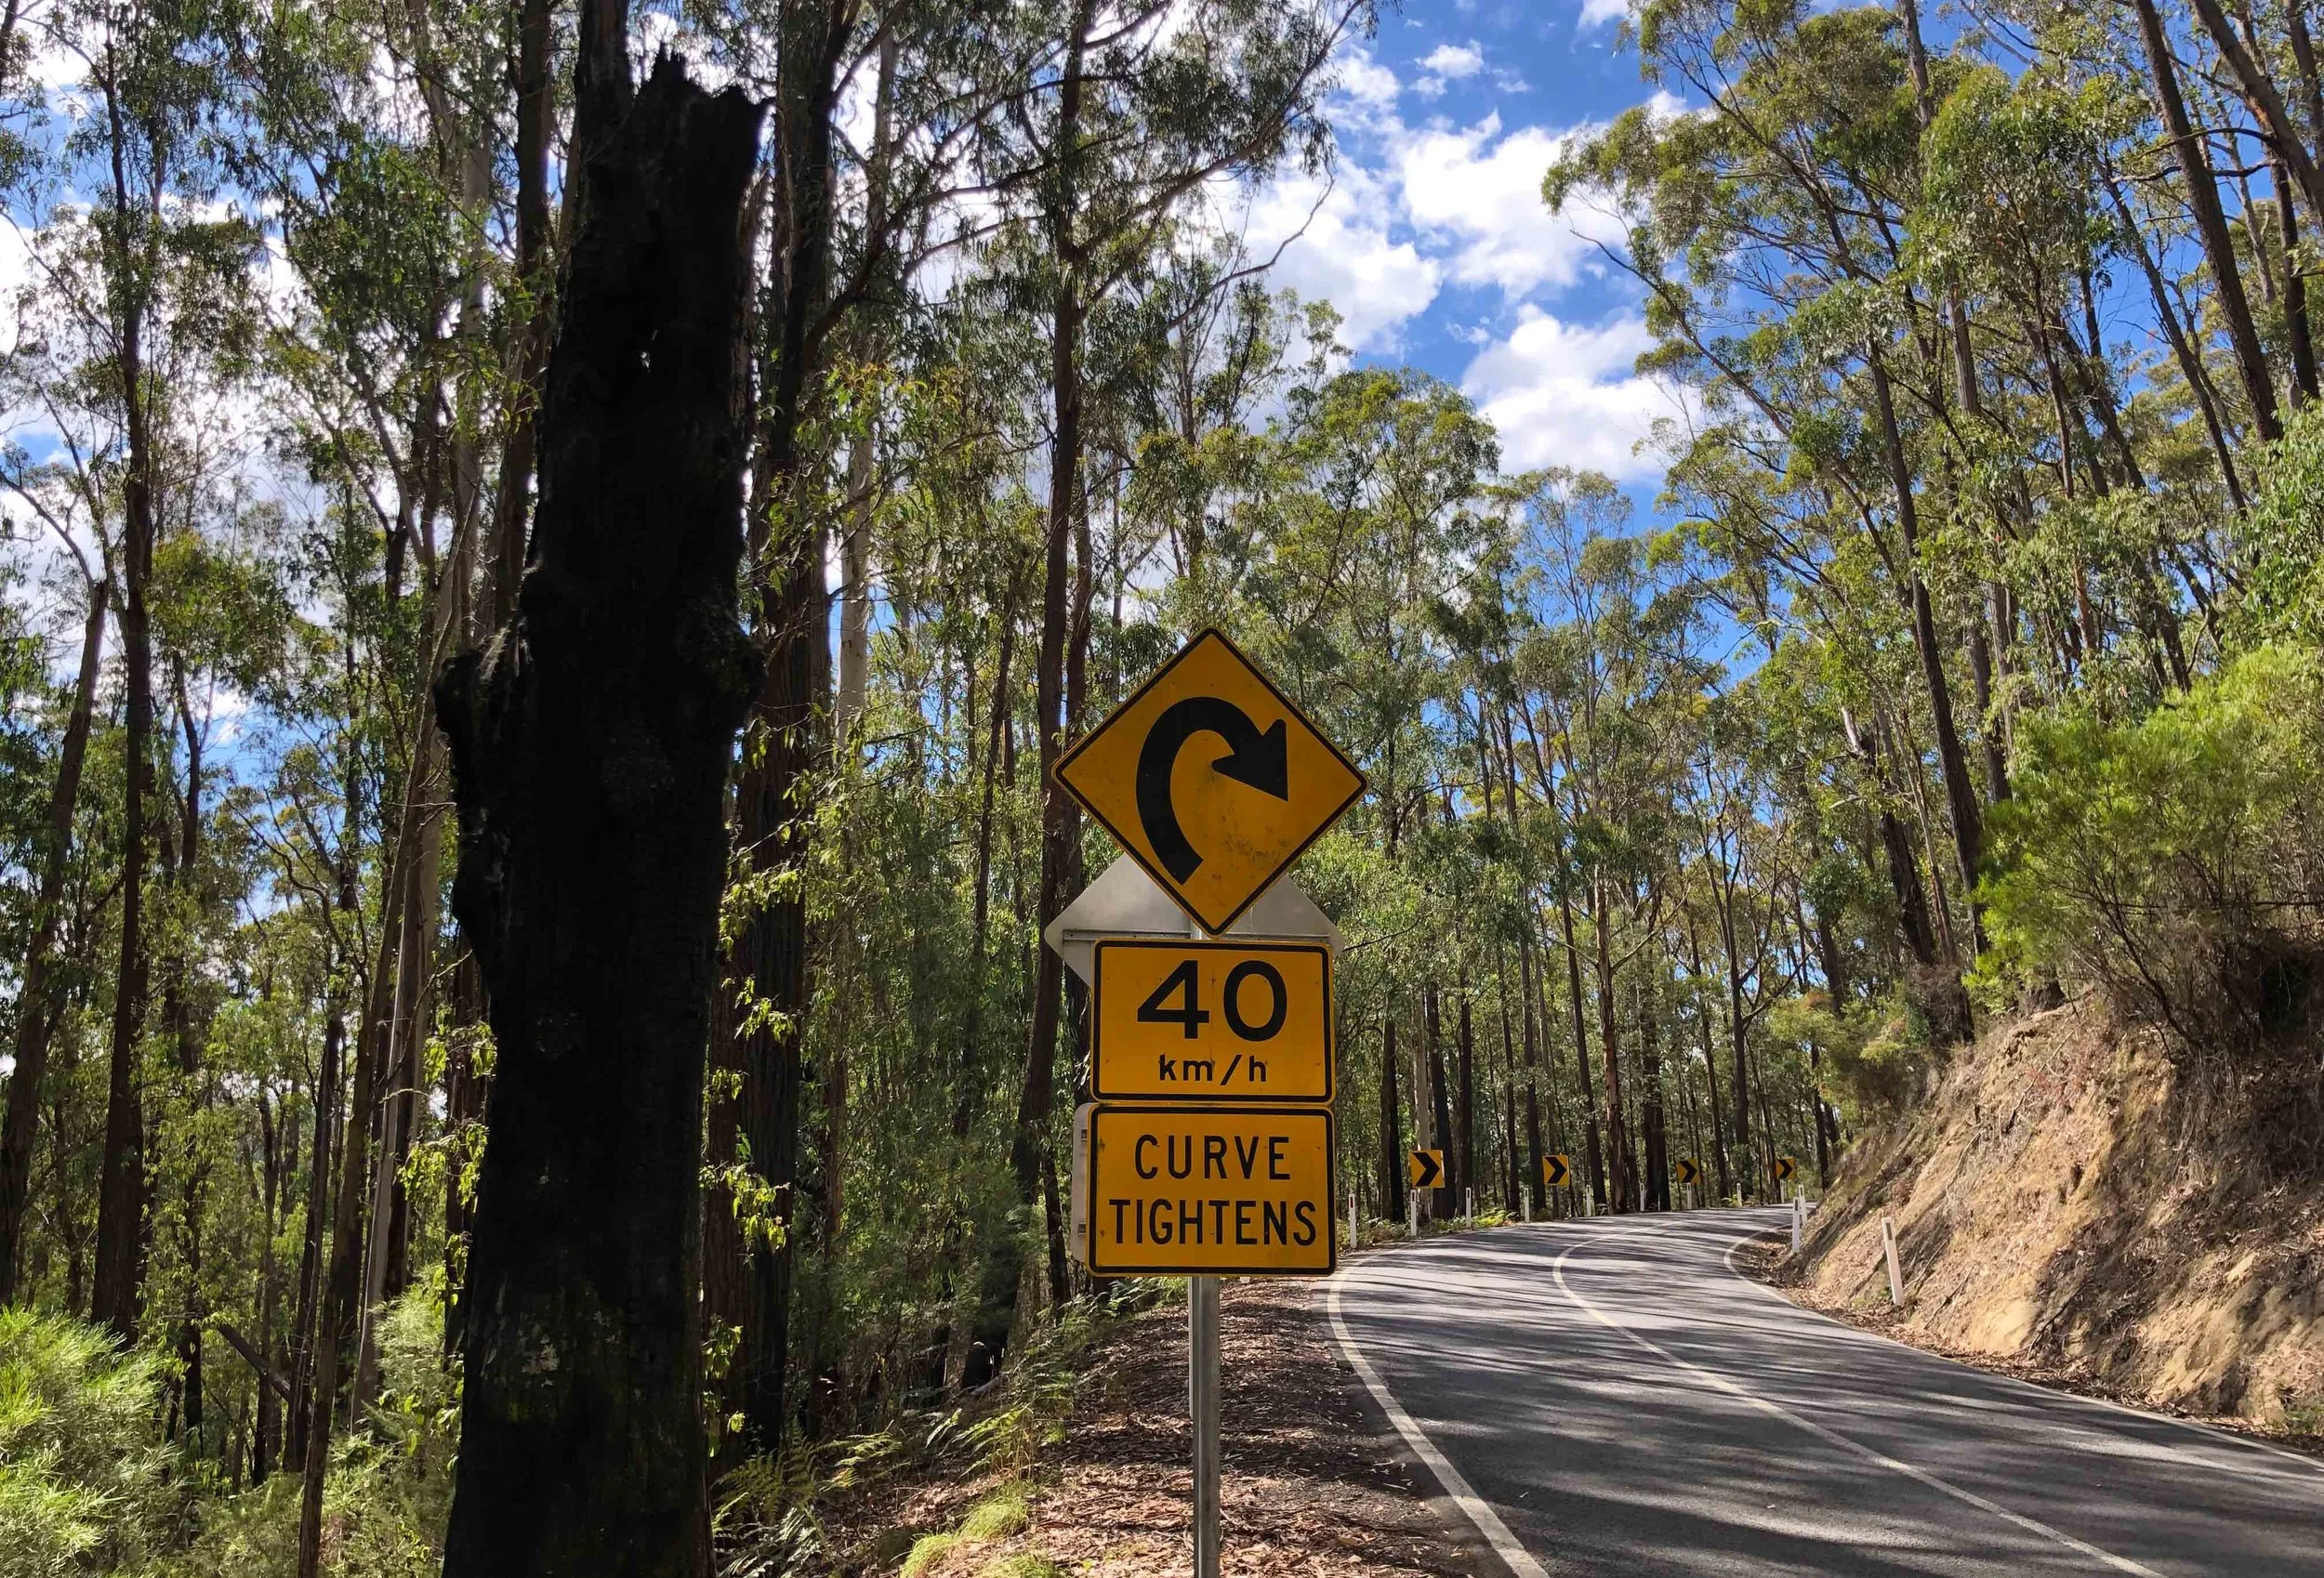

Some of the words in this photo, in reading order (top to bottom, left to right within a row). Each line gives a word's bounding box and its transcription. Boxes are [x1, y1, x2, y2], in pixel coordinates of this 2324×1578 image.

[1137, 959, 1287, 1042] 40
[1159, 1054, 1267, 1085] km/h
[1134, 1134, 1291, 1181] CURVE
[1108, 1198, 1317, 1247] TIGHTENS
